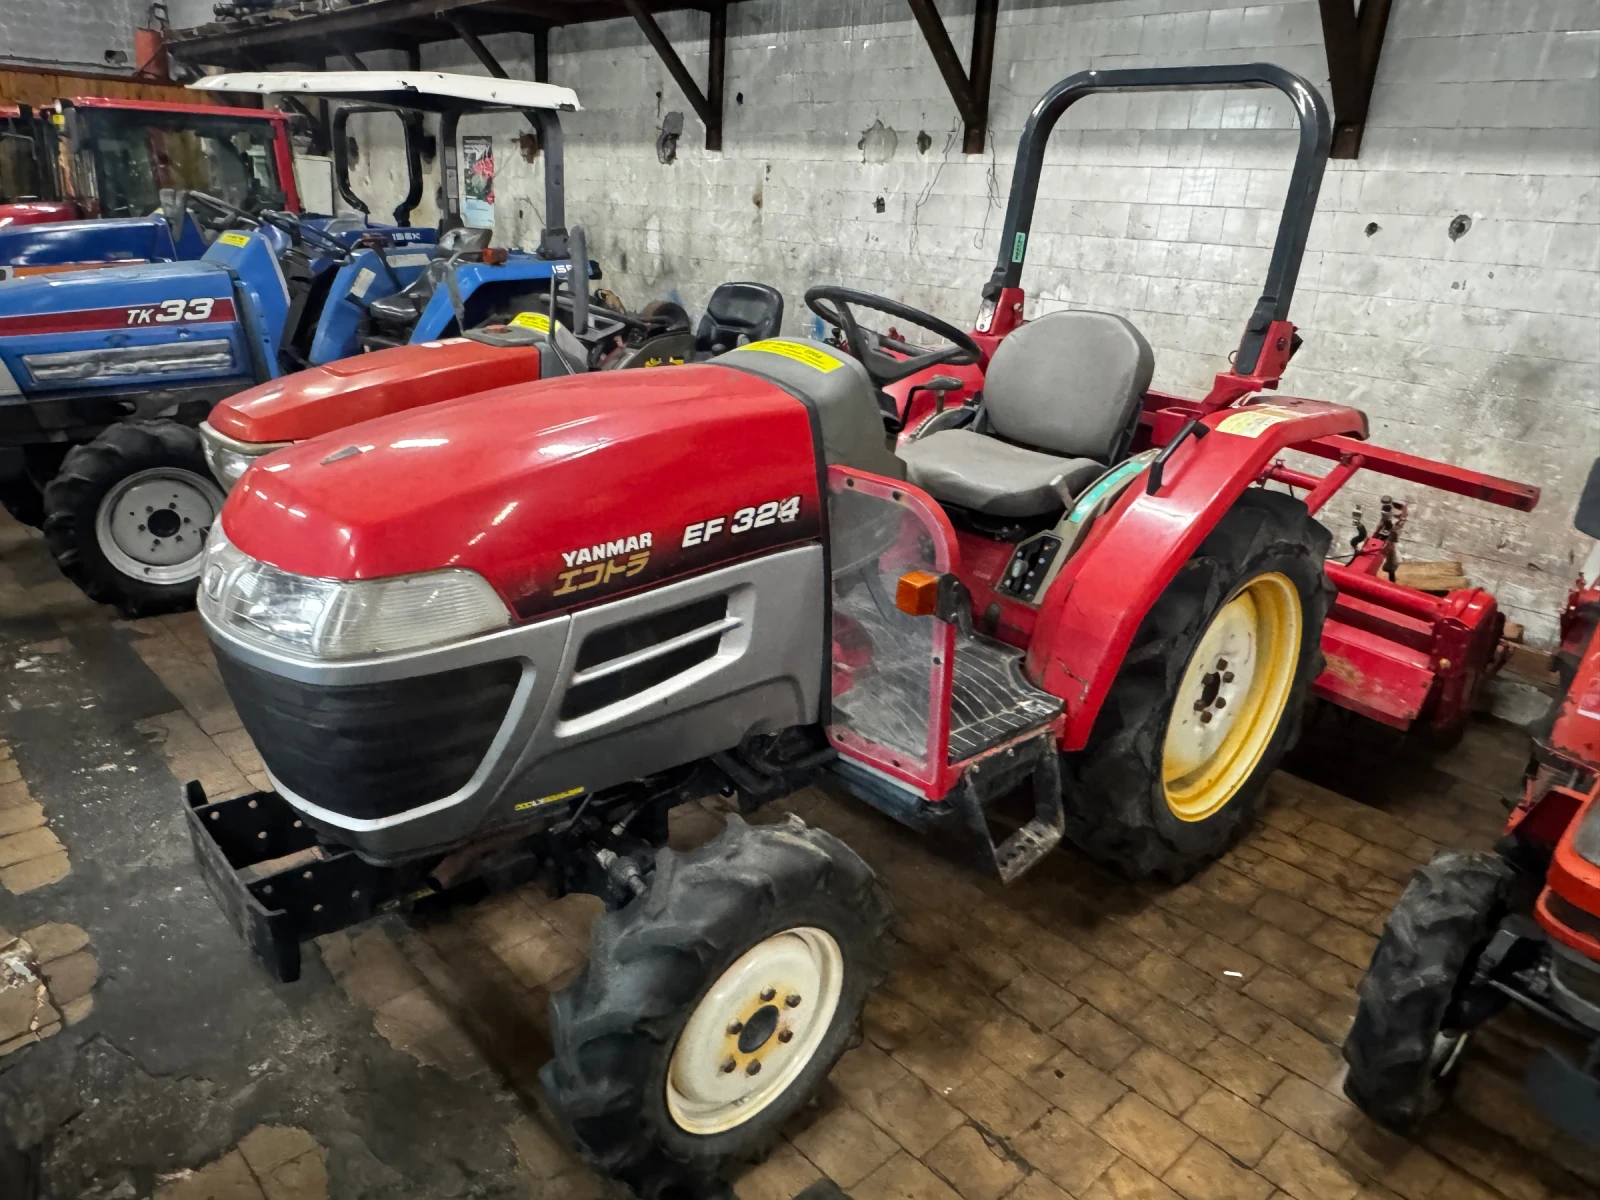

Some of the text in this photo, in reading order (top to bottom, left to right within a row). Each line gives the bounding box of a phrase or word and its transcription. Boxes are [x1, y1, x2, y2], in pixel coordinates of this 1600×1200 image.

[127, 297, 215, 325] TK 33
[681, 495, 801, 548] EF 324
[561, 531, 653, 568] YANMAR
[552, 550, 651, 597] エコトラ
